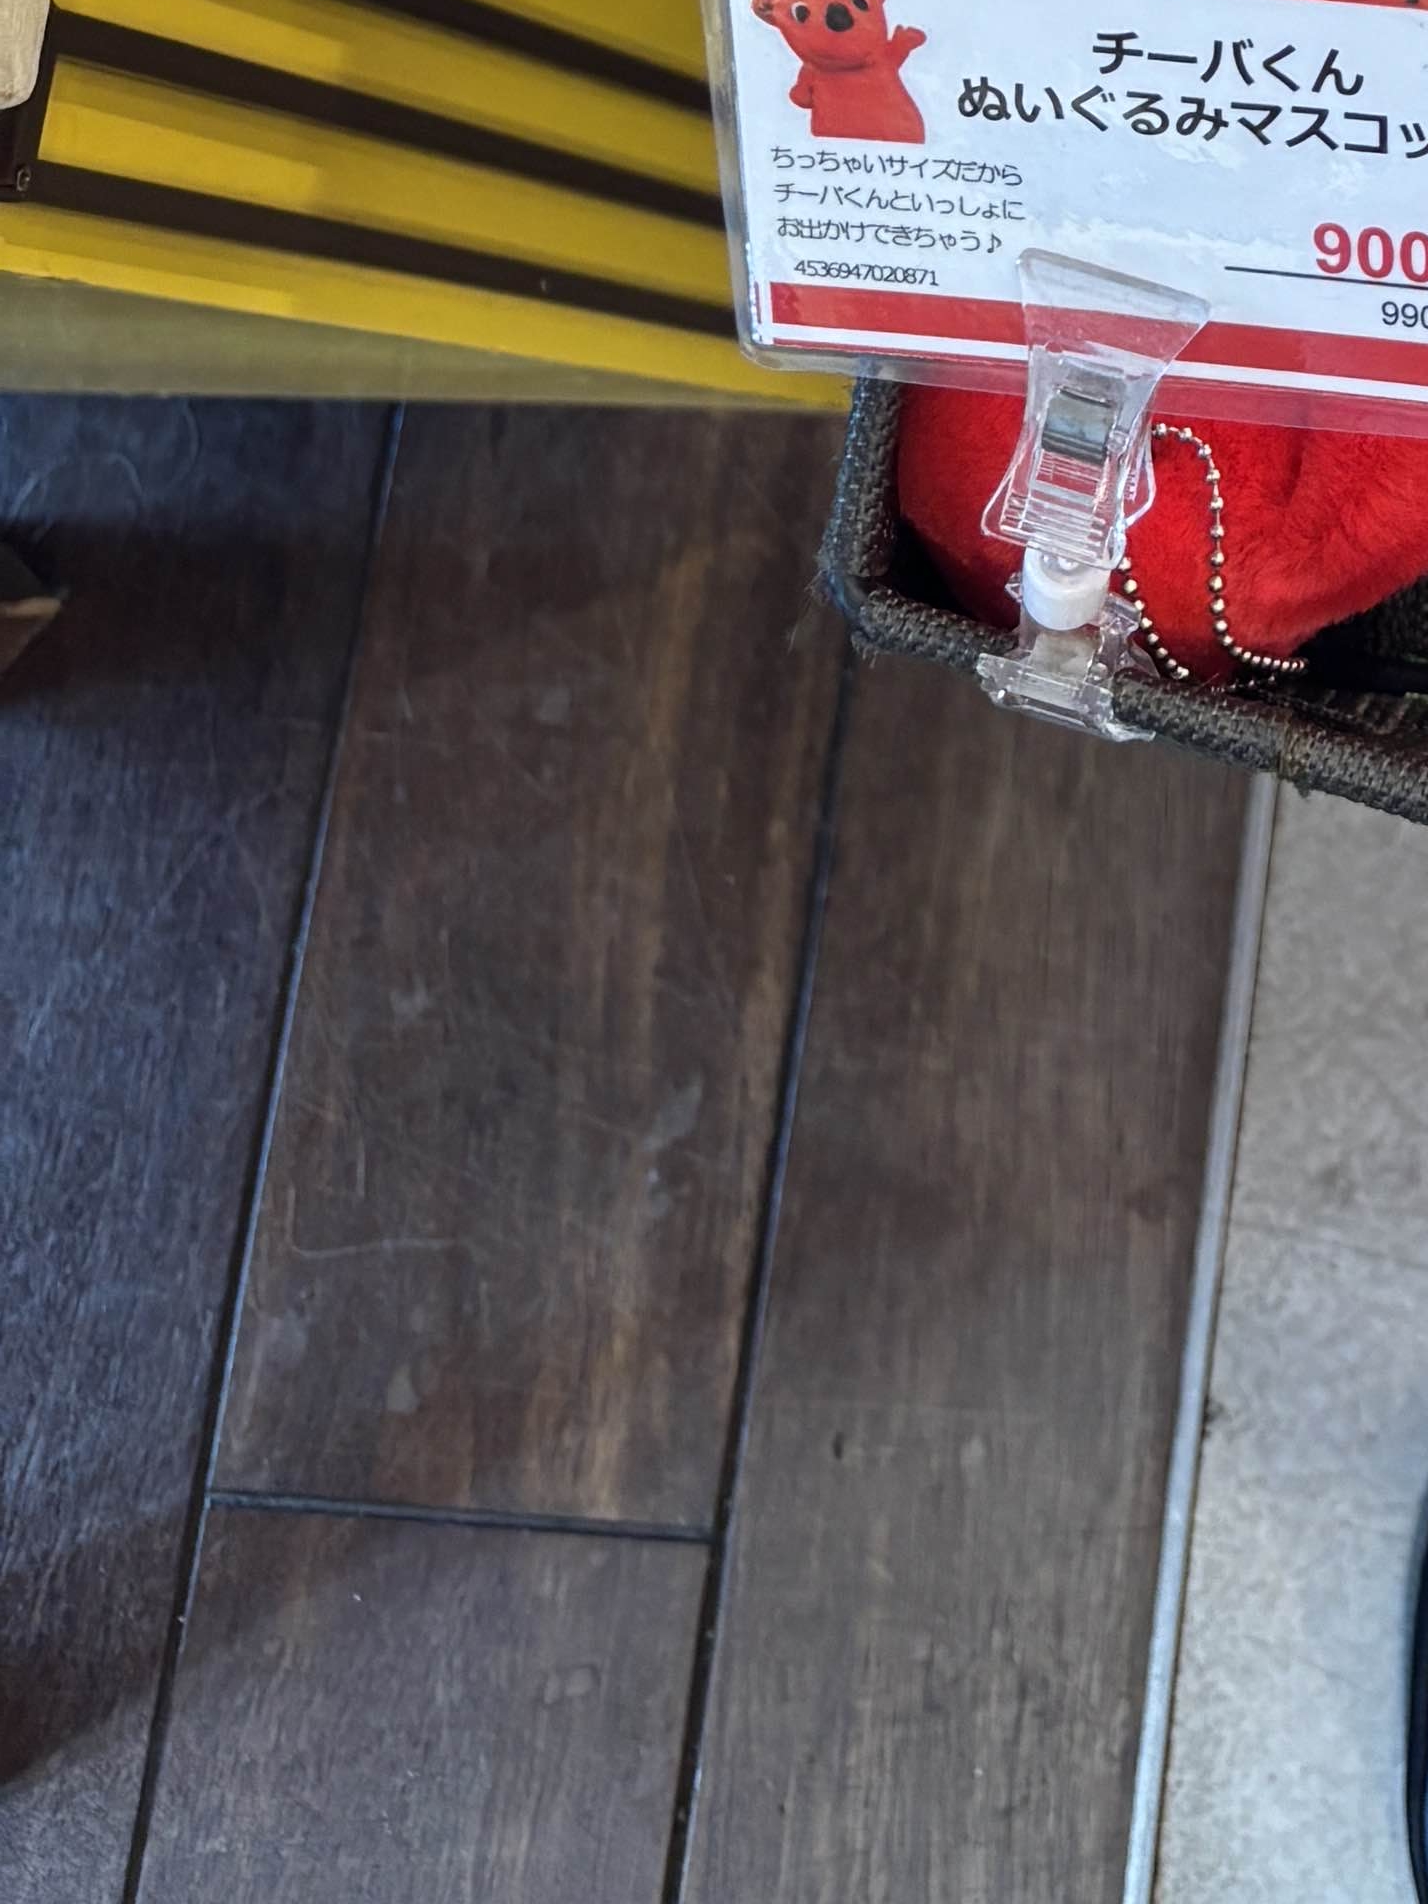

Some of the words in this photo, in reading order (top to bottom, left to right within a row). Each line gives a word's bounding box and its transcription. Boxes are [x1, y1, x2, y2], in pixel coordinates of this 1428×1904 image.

[1092, 31, 1365, 96] チーバくん
[770, 146, 1024, 187] ちっちゃいサイズだから
[773, 183, 1027, 221] チーバくんといっしょに
[793, 259, 940, 287] 4536947020871
